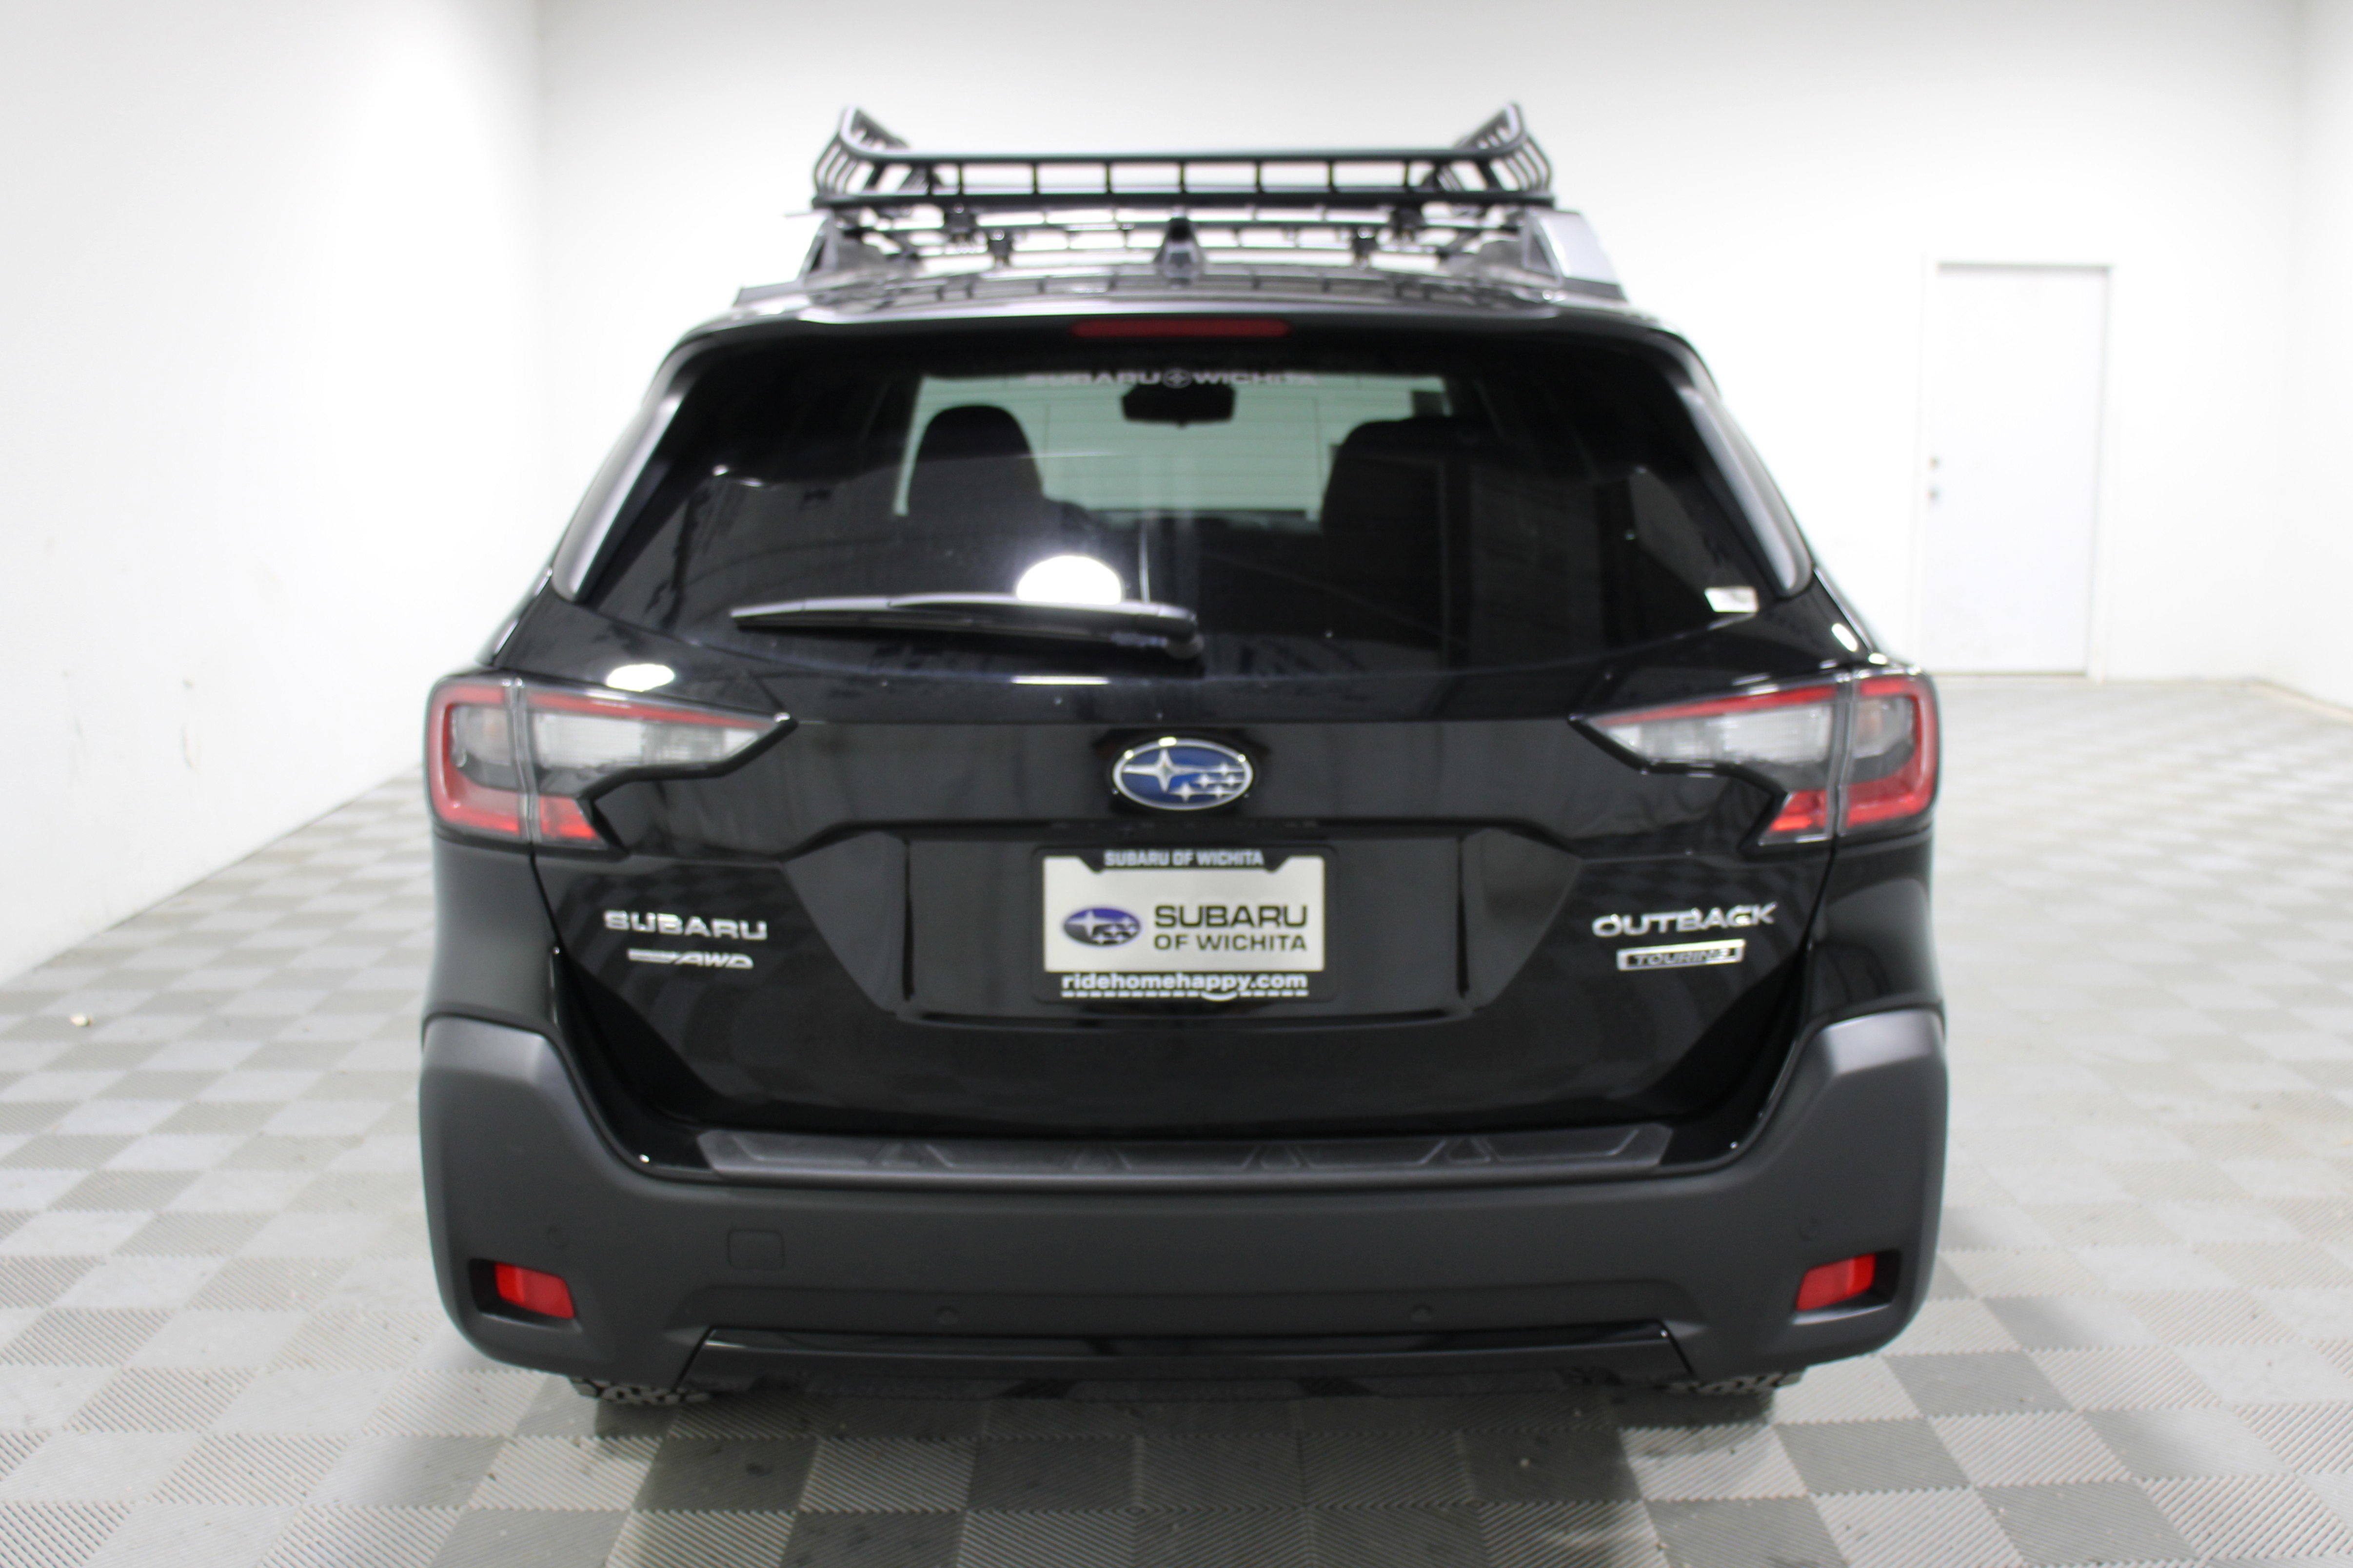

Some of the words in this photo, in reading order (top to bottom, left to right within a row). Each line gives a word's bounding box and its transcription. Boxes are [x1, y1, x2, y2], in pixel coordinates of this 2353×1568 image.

[1103, 850, 1170, 866] SUBARU
[1172, 851, 1193, 865] OF
[1196, 850, 1264, 866] WICHITA
[603, 910, 768, 940] SUBARU
[1154, 905, 1307, 928] SUBARU
[1592, 901, 1778, 937] OUTBACK
[1154, 934, 1190, 951] OF
[1196, 934, 1307, 951] WICHITA
[674, 951, 754, 969] AWD
[1061, 973, 1308, 992] ridehomehappy.com
